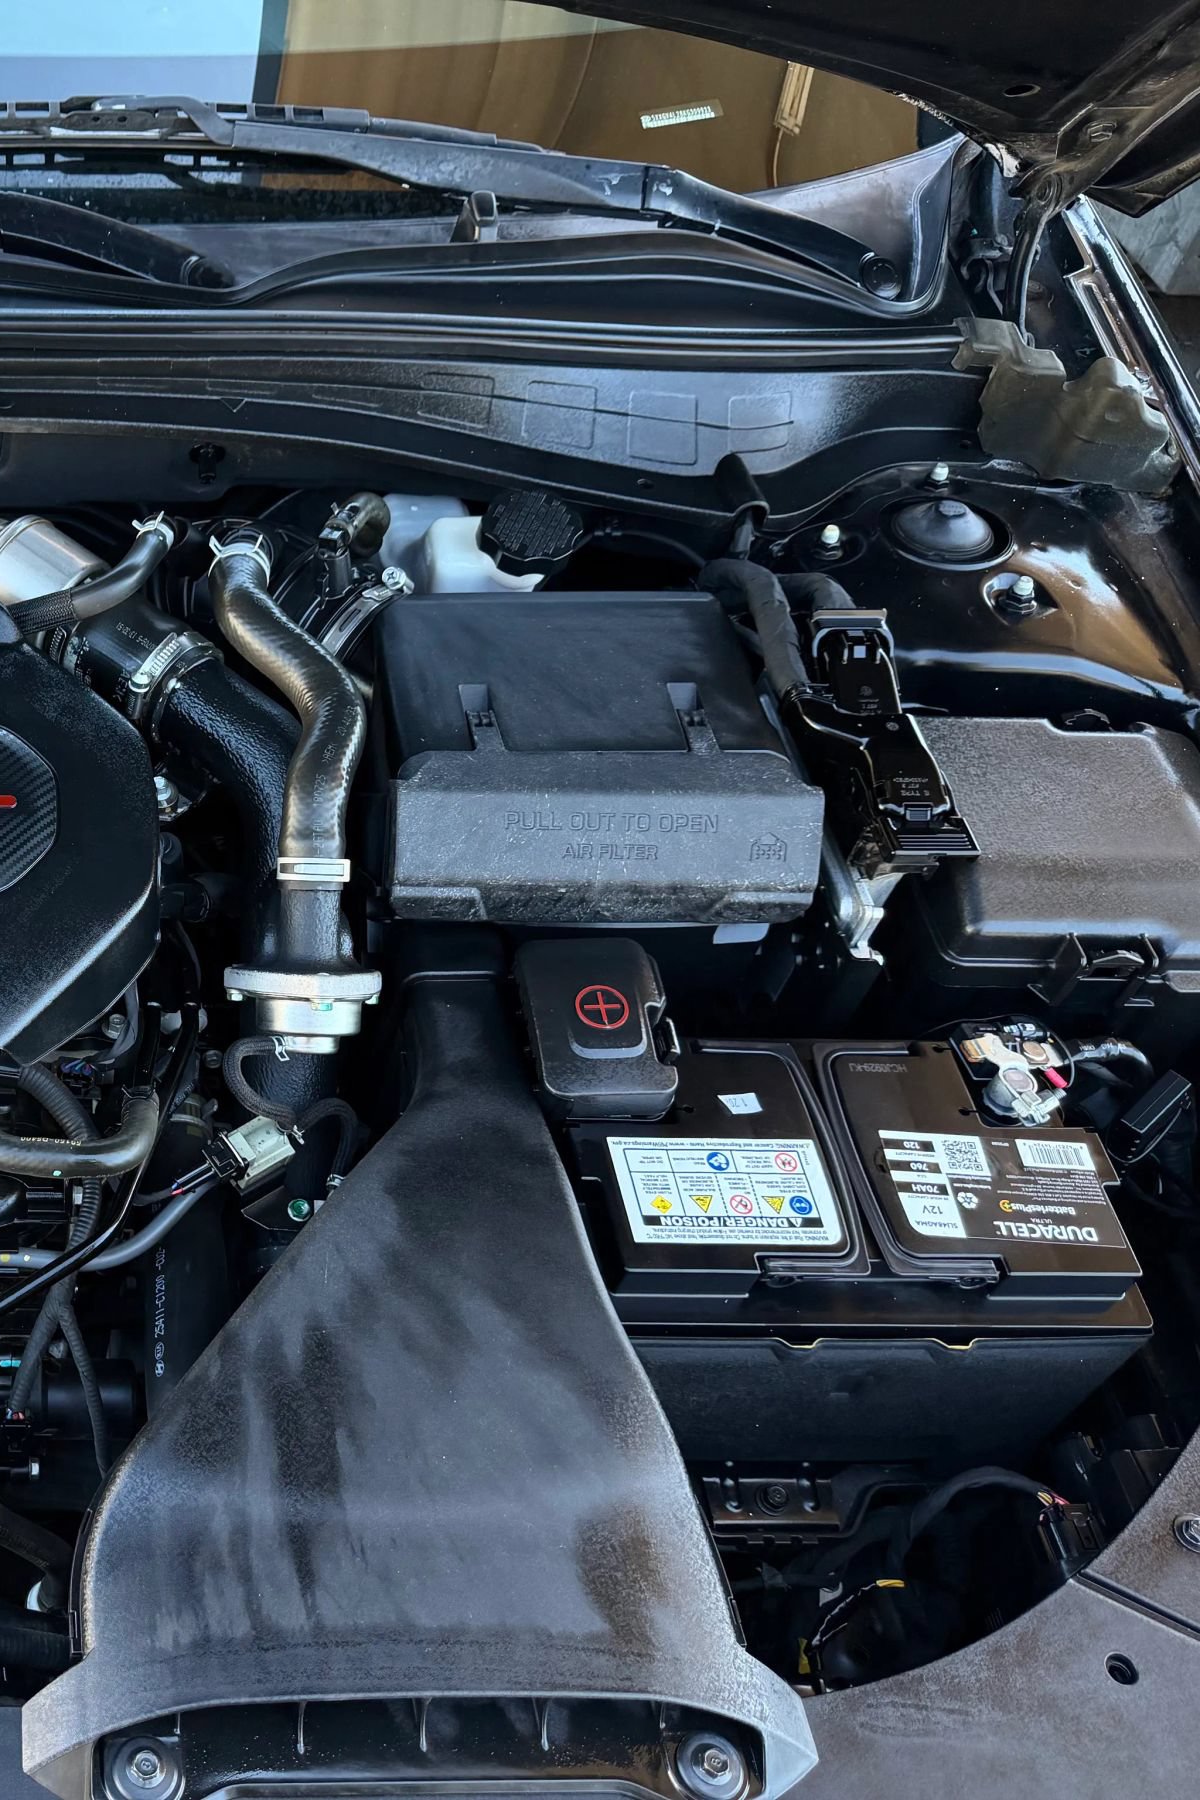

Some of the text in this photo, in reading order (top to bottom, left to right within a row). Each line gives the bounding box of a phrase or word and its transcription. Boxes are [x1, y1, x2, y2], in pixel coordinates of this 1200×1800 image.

[504, 811, 719, 834] PULL OUT TO OPEN
[562, 843, 659, 860] AIR FILTER
[903, 1141, 920, 1149] 120
[910, 1162, 928, 1171] 760
[911, 1184, 940, 1193] 70AH
[922, 1205, 943, 1214] 12V
[1010, 1202, 1075, 1215] BatteriesPlus
[660, 1216, 788, 1227] DANGER/POISON
[993, 1220, 1098, 1241] DURACELL
